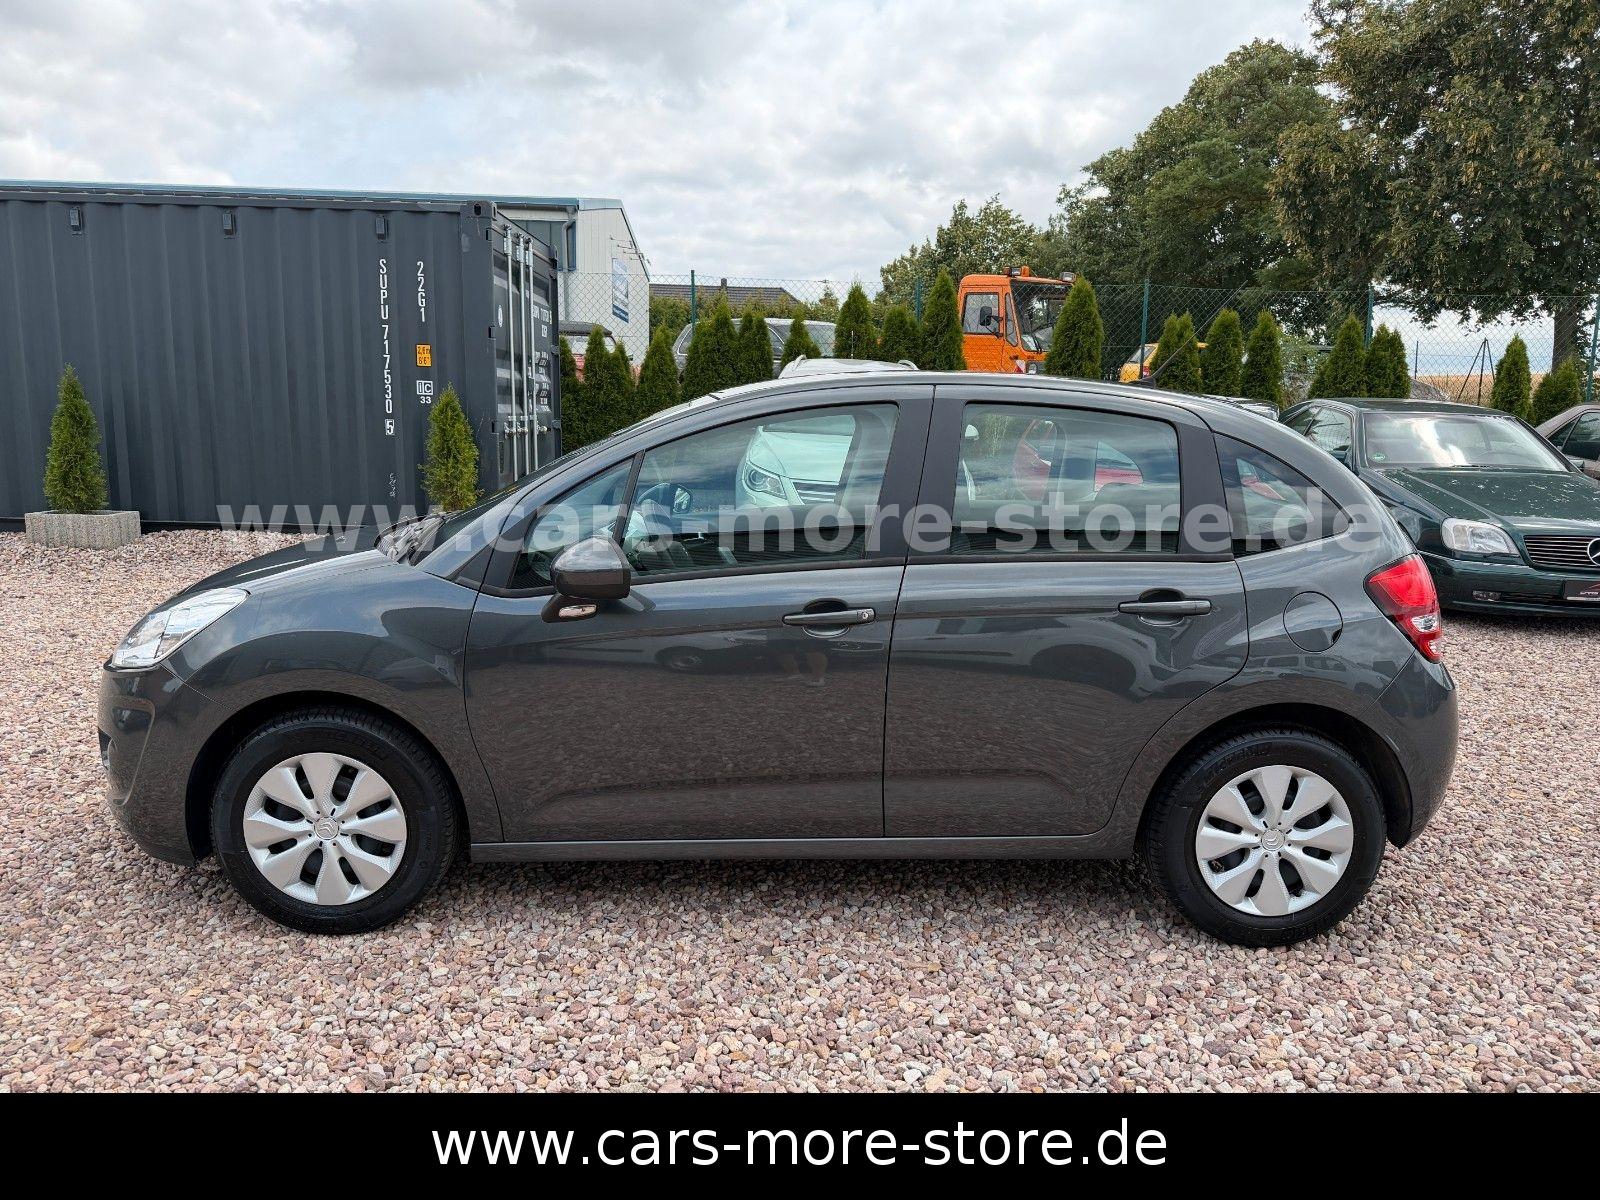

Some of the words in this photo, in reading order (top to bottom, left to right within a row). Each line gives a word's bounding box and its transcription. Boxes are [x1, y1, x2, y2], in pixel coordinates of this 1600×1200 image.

[379, 258, 389, 320] SUPU
[416, 261, 426, 322] 22G1
[381, 324, 393, 414] 717530
[385, 419, 394, 435] 5
[420, 396, 432, 404] 33
